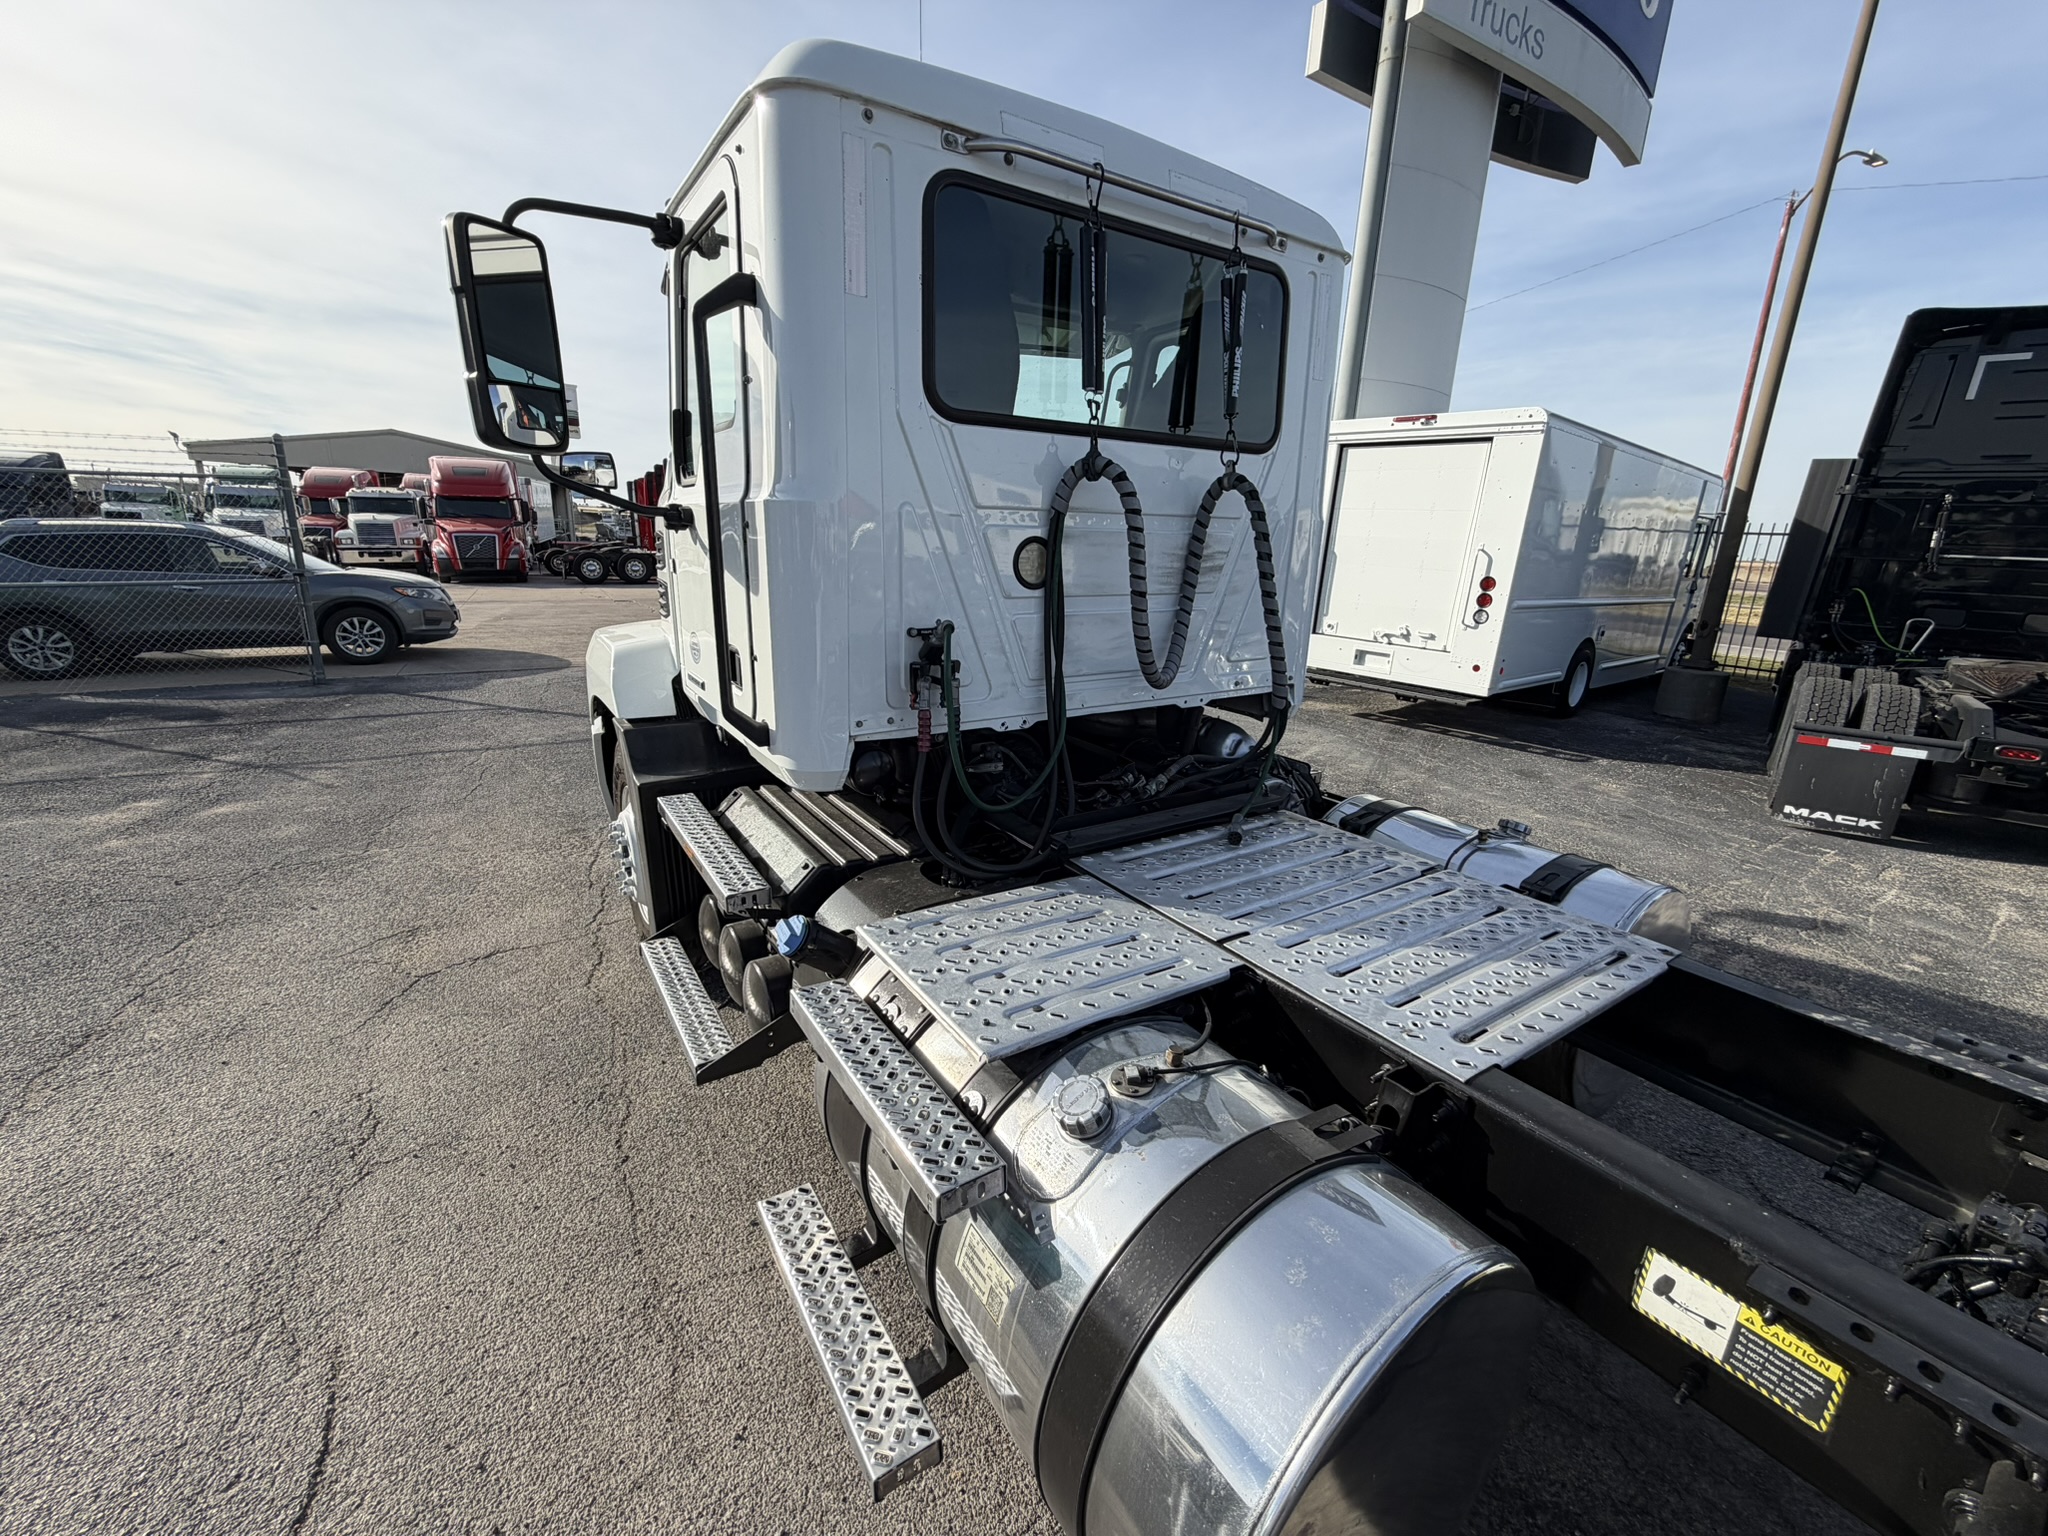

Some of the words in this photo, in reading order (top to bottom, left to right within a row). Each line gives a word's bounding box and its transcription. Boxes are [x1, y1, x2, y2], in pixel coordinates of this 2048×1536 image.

[1223, 296, 1231, 333] TRACKER
[1231, 346, 1243, 398] PHILIPS
[1783, 804, 1884, 831] MACK
[1738, 1335, 1747, 1344] To
[1747, 1342, 1769, 1358] avoid
[1769, 1355, 1791, 1372] frame
[1740, 1328, 1765, 1346] Frame
[1766, 1343, 1773, 1351] is
[1760, 1325, 1832, 1372] CAUTION
[1729, 1358, 1752, 1375] notch
[1752, 1372, 1775, 1390] frame
[1732, 1350, 1743, 1360] do
[1744, 1358, 1762, 1372] NOT
[1780, 1382, 1795, 1393] cut
[1794, 1391, 1805, 1399] or
[1734, 1343, 1746, 1352] do
[1746, 1350, 1765, 1364] NOT
[1765, 1362, 1783, 1377] heat
[1783, 1374, 1794, 1382] or
